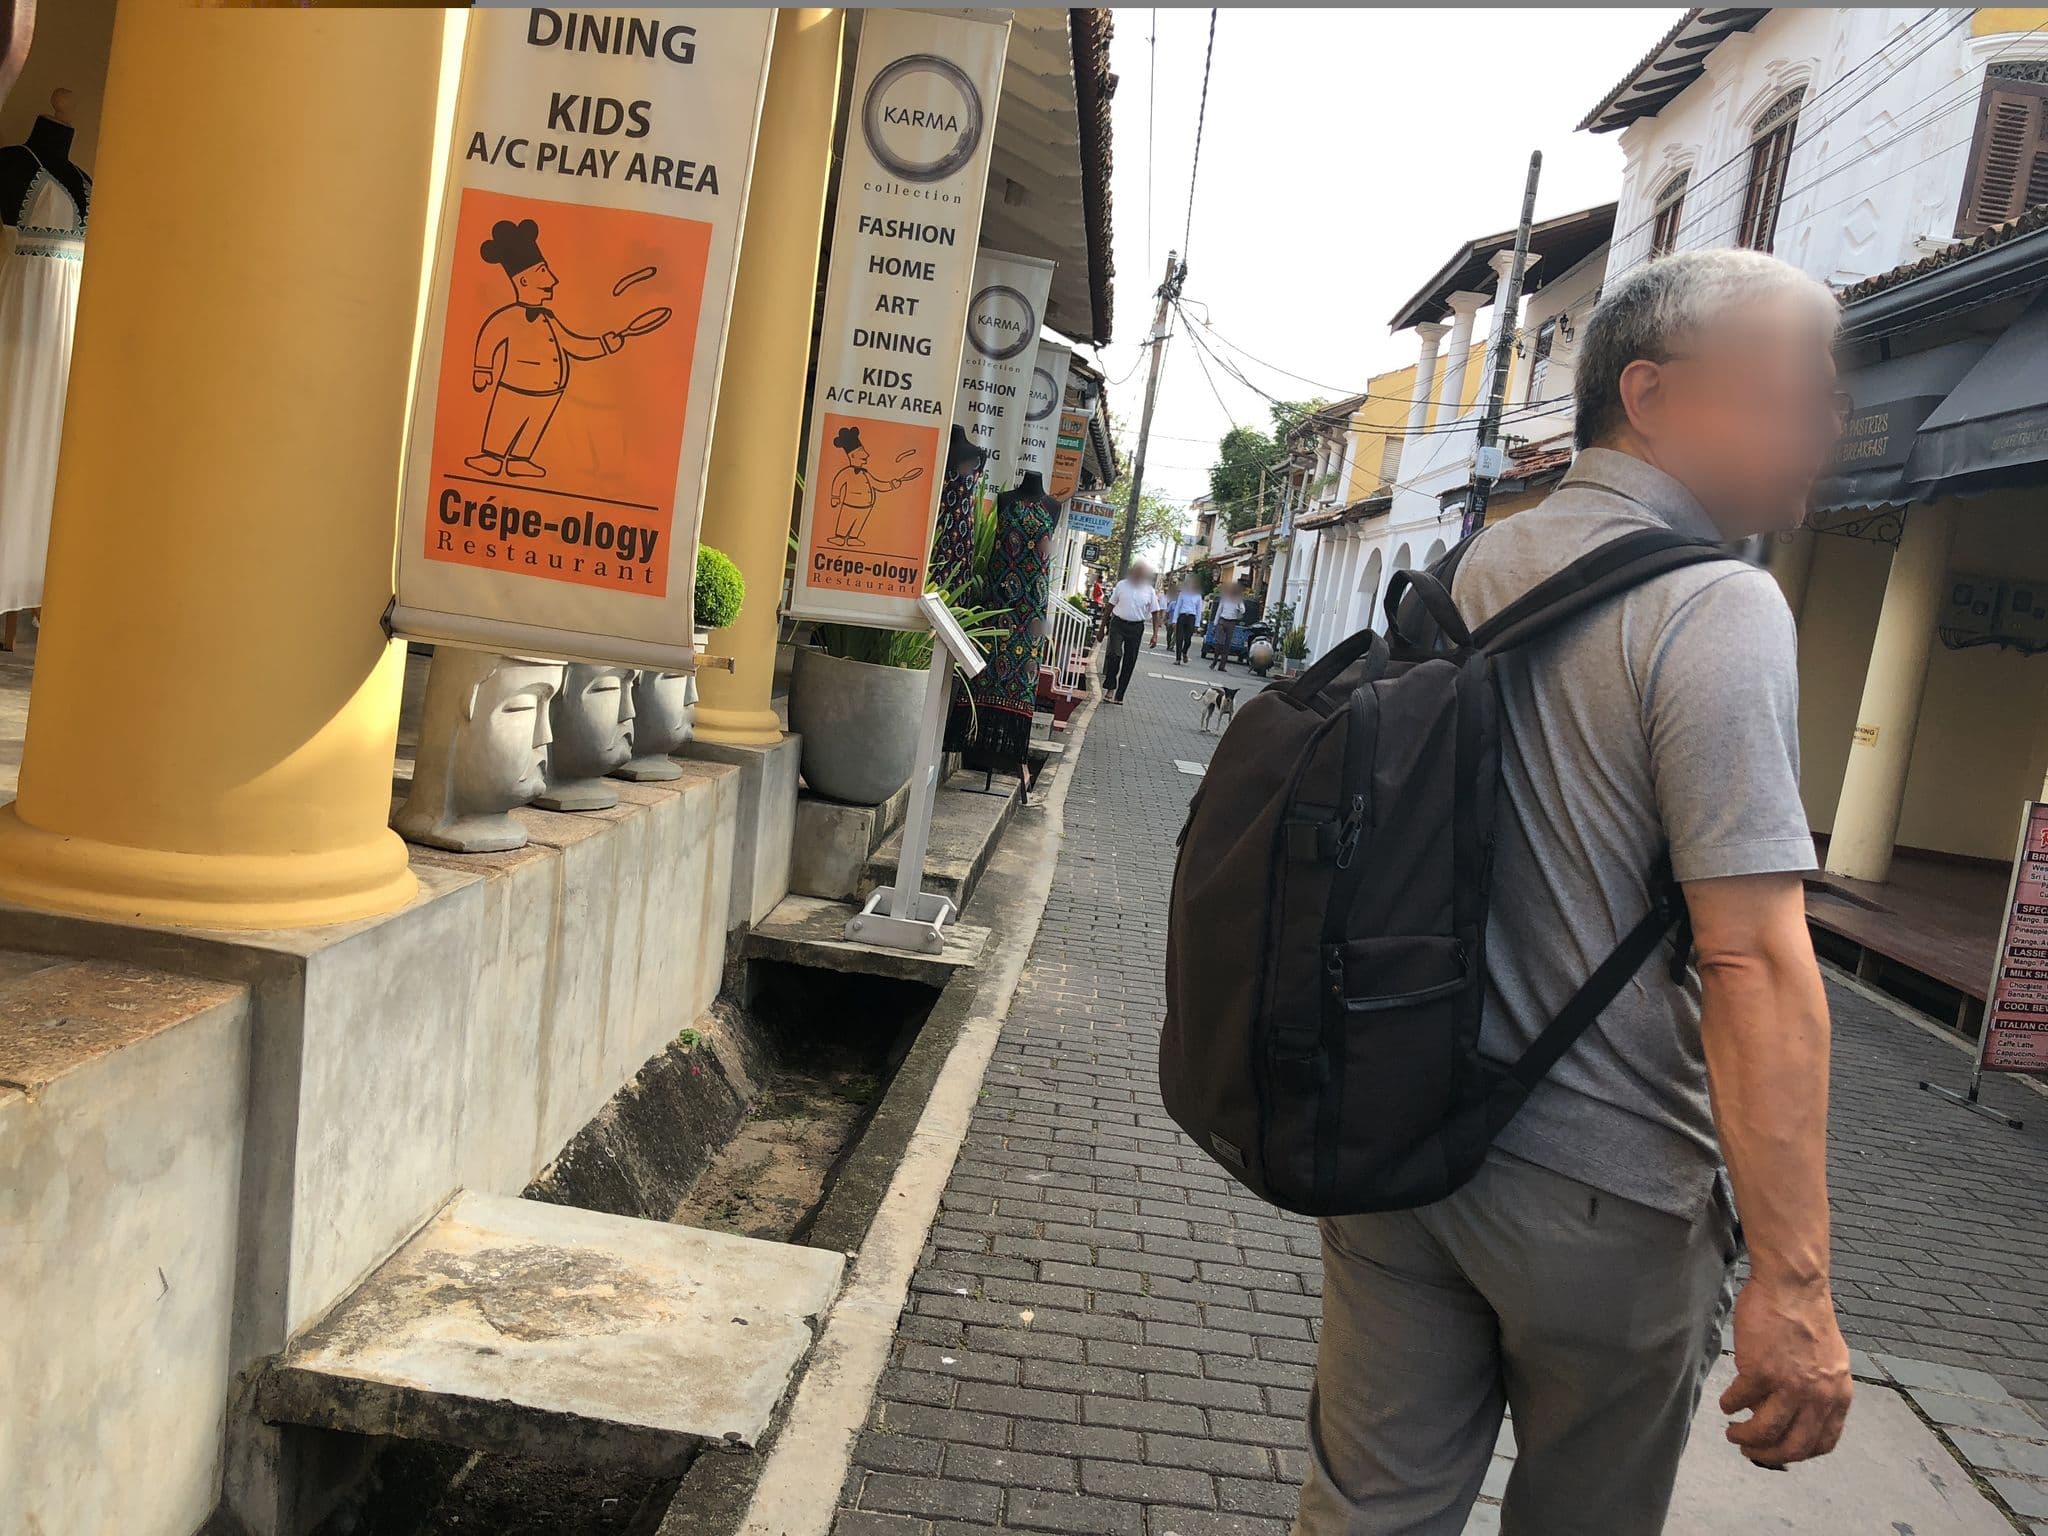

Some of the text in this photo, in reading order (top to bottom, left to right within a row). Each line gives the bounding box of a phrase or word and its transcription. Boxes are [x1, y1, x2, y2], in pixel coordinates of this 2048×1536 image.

[527, 8, 697, 64] DINING
[547, 92, 652, 138] KIDS
[884, 106, 958, 132] KARMA
[466, 131, 719, 195] A/C PLAY AREA
[863, 180, 962, 204] collection
[858, 215, 956, 246] FASHION
[868, 255, 936, 281] HOME
[875, 294, 919, 316] ART
[978, 315, 1020, 331] KARMA
[853, 328, 932, 356] DINING
[966, 359, 1021, 373] collection
[862, 367, 912, 390] KIDS
[962, 378, 1016, 397] FASHION
[826, 386, 942, 415] A/C PLAY AREA
[1029, 390, 1048, 401] RMA
[968, 401, 1004, 417] HOME
[971, 424, 995, 437] ART
[1021, 437, 1046, 448] HION
[439, 488, 659, 563] Crépe-ology
[437, 530, 654, 583] Restaurant
[814, 553, 918, 584] Crépe-ology
[813, 573, 915, 593] Restaurant
[2014, 949, 2046, 958] LASSIE
[2010, 969, 2032, 977] MILK
[2000, 1020, 2036, 1030] ITALIAN
